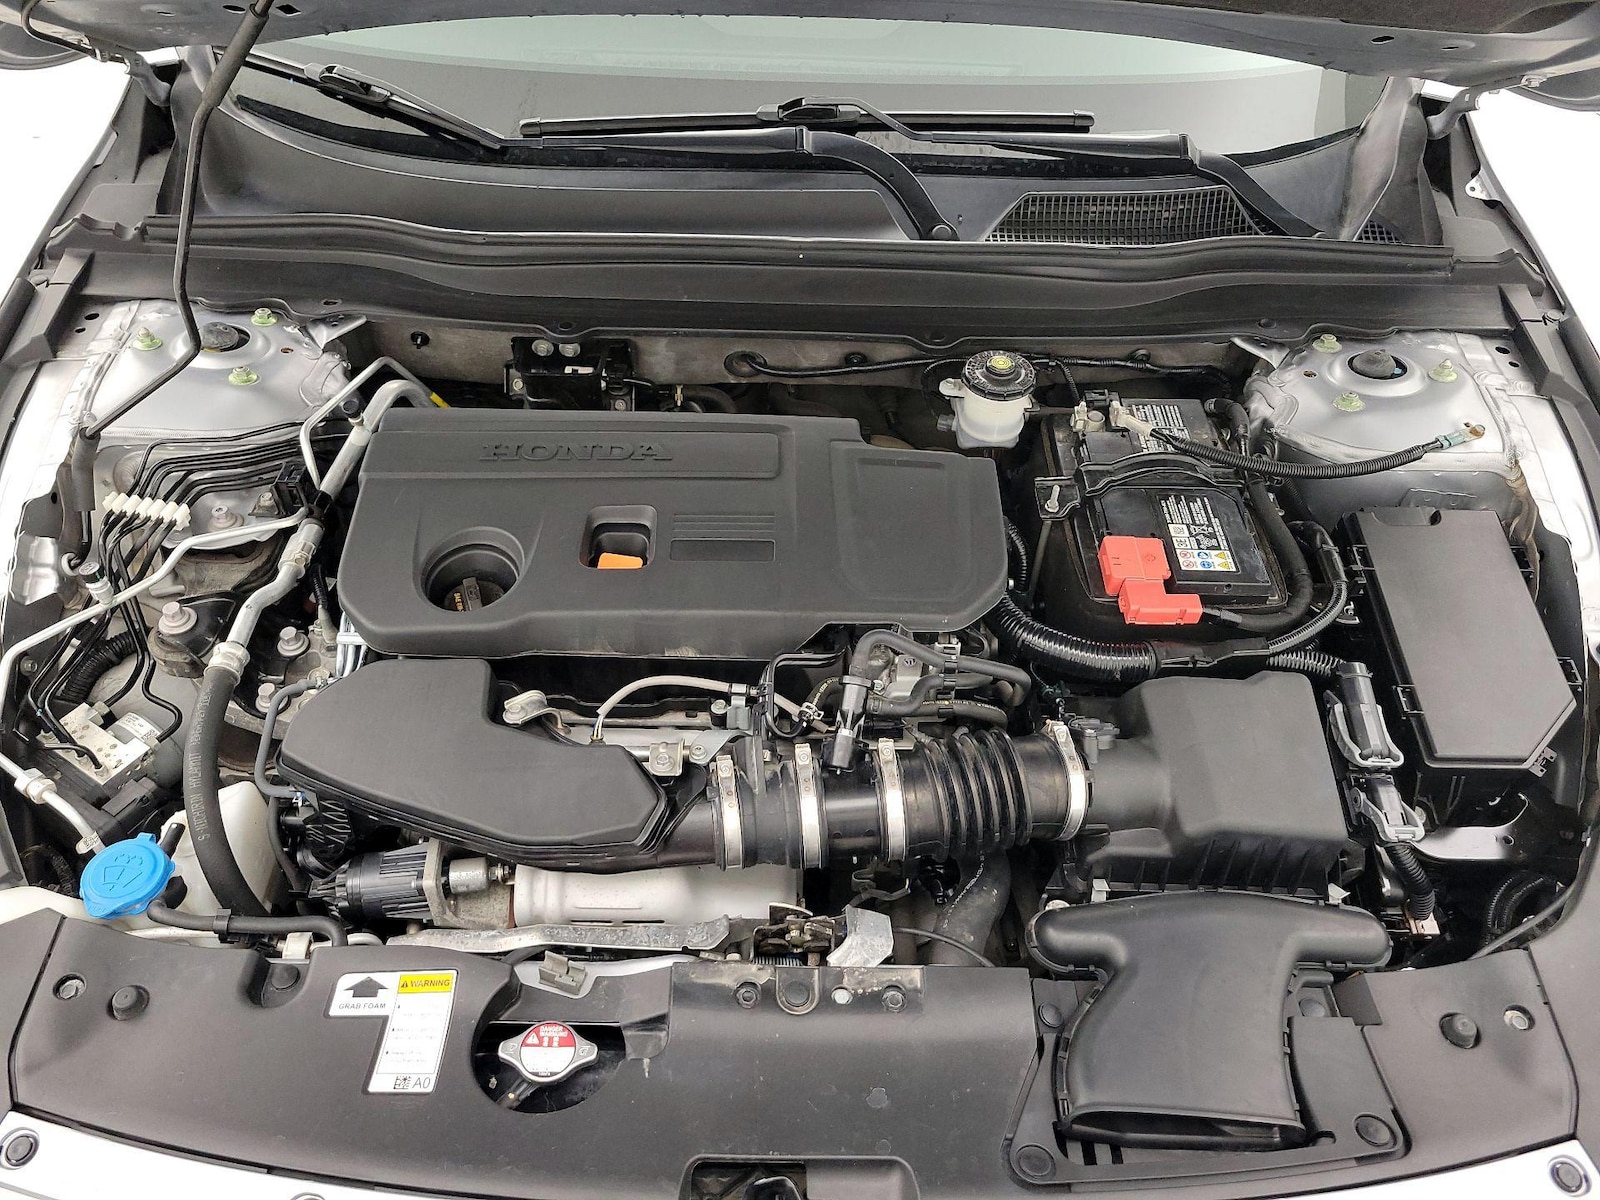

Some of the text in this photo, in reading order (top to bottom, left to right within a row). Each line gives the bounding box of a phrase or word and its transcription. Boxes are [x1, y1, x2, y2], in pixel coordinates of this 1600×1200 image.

[479, 443, 673, 460] HONDA
[411, 978, 450, 987] WARNING
[338, 1002, 386, 1010] GRAB FOAM
[412, 1076, 431, 1089] A0
